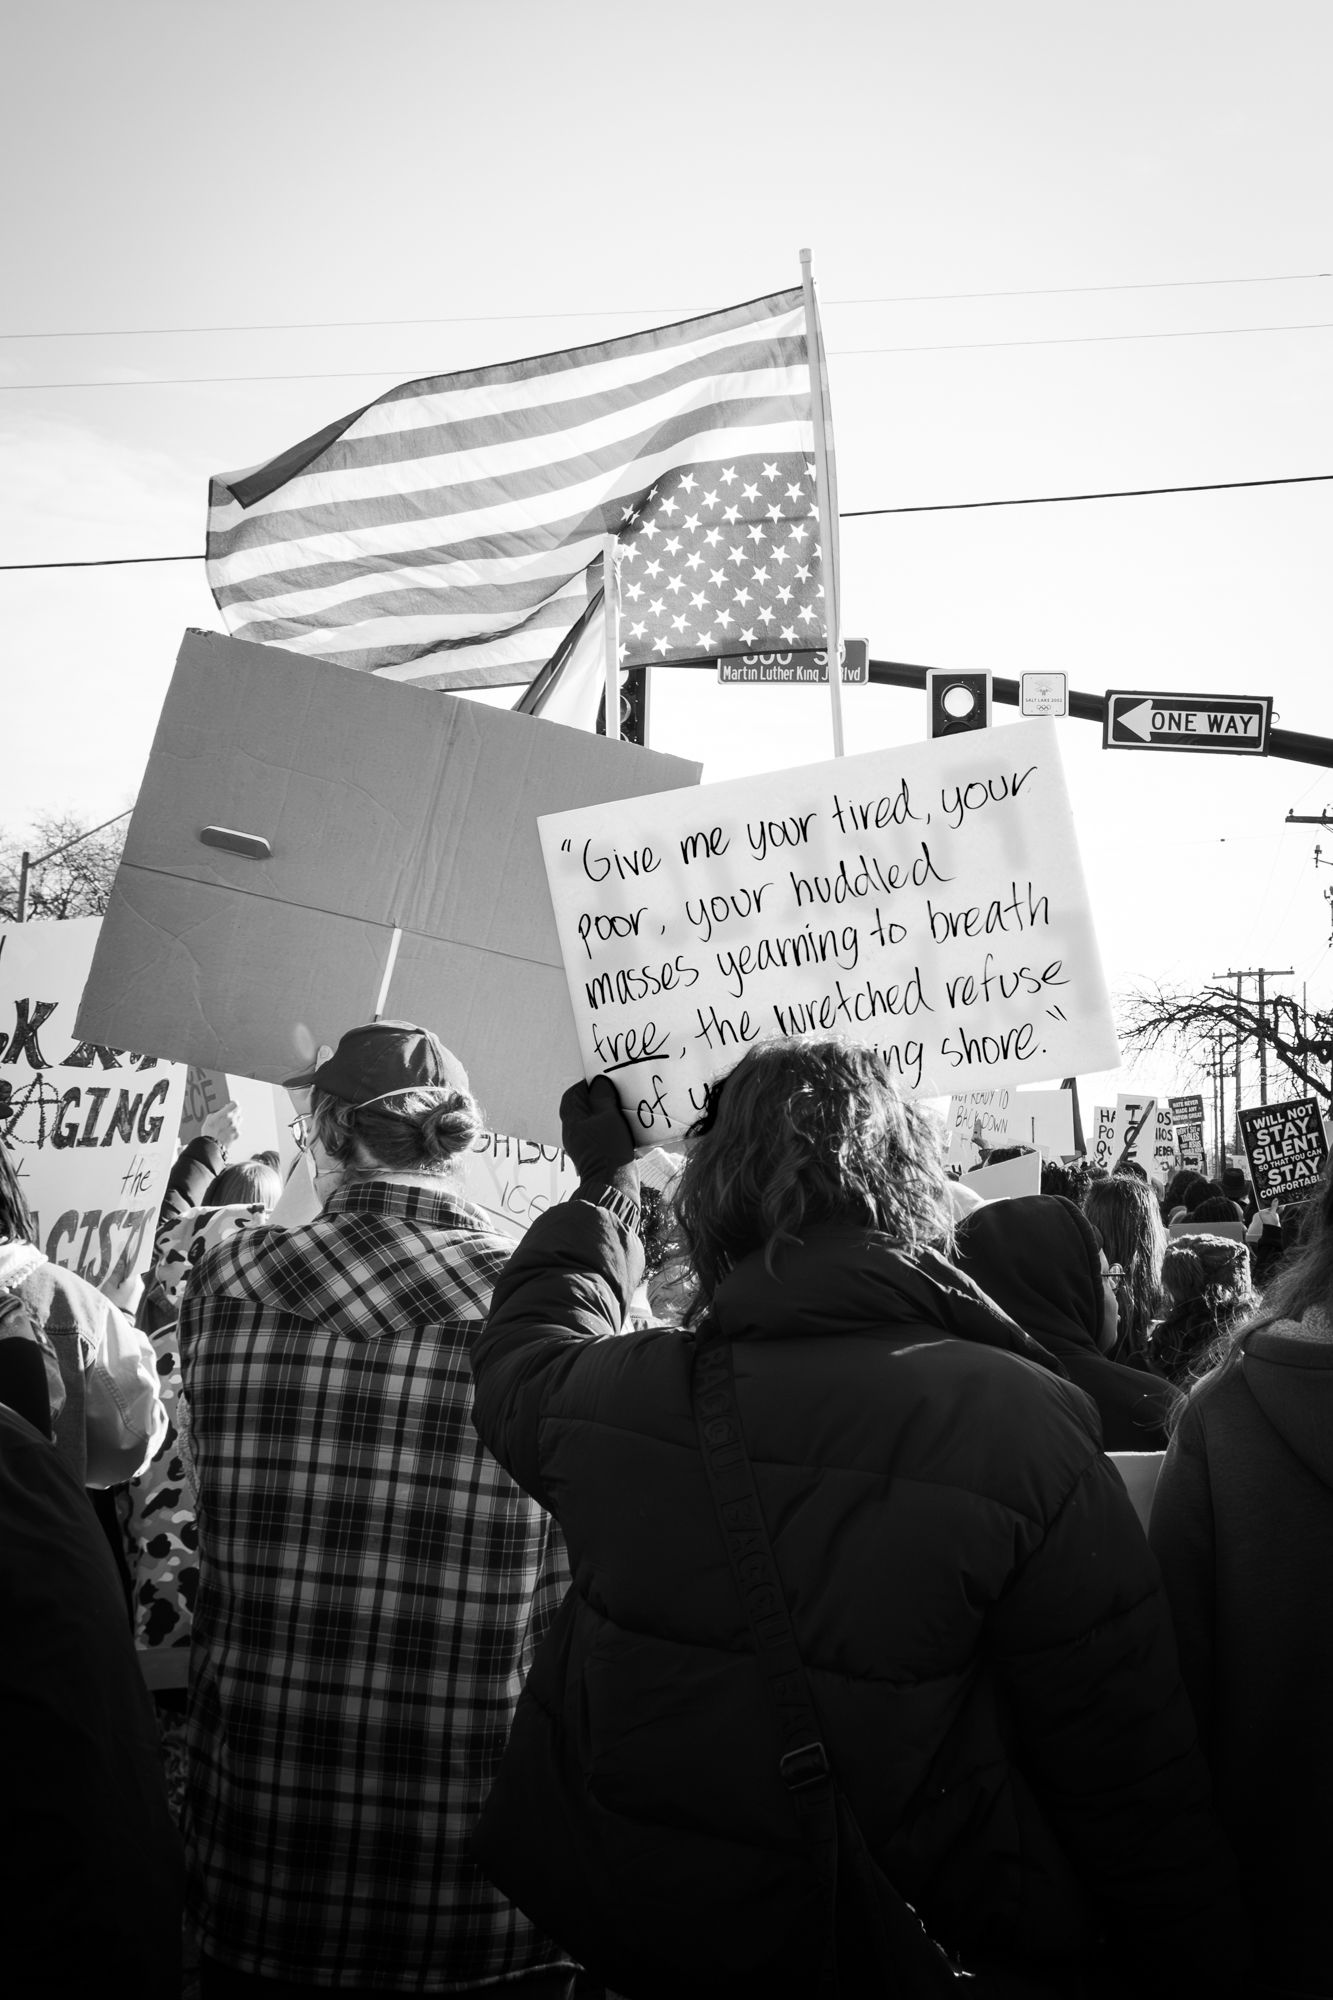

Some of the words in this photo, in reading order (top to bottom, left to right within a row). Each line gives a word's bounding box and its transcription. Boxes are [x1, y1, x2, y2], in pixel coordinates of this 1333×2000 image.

[723, 665, 758, 681] Martin
[760, 665, 794, 681] Luther
[796, 666, 819, 682] King
[1151, 711, 1197, 732] ONE
[1207, 714, 1253, 734] WAY
[680, 827, 731, 864] me
[747, 813, 817, 860] your
[832, 778, 931, 833] tired,
[941, 766, 1038, 829] your
[686, 882, 775, 942] your
[790, 842, 957, 907] huddled
[585, 955, 700, 1010] masses
[717, 924, 858, 998] yearning
[870, 907, 907, 946] to
[927, 881, 1049, 944] breath
[694, 1006, 761, 1049] the
[774, 967, 934, 1036] wretched
[946, 953, 1071, 1008] refuse
[0, 1072, 170, 1150] AGING
[636, 1074, 672, 1128] of
[1245, 1121, 1251, 1132] I
[1253, 1112, 1285, 1130] WILL
[1287, 1103, 1314, 1120] NOT
[1256, 1116, 1310, 1146] STAY
[1252, 1132, 1319, 1165] SILENT
[1258, 1164, 1269, 1172] SO
[1270, 1158, 1289, 1168] THAT
[1290, 1152, 1305, 1162] YOU
[1306, 1148, 1322, 1158] CAN
[121, 1154, 153, 1197] the
[1260, 1174, 1322, 1199] COMFORTABL
[1267, 1156, 1320, 1186] STAY
